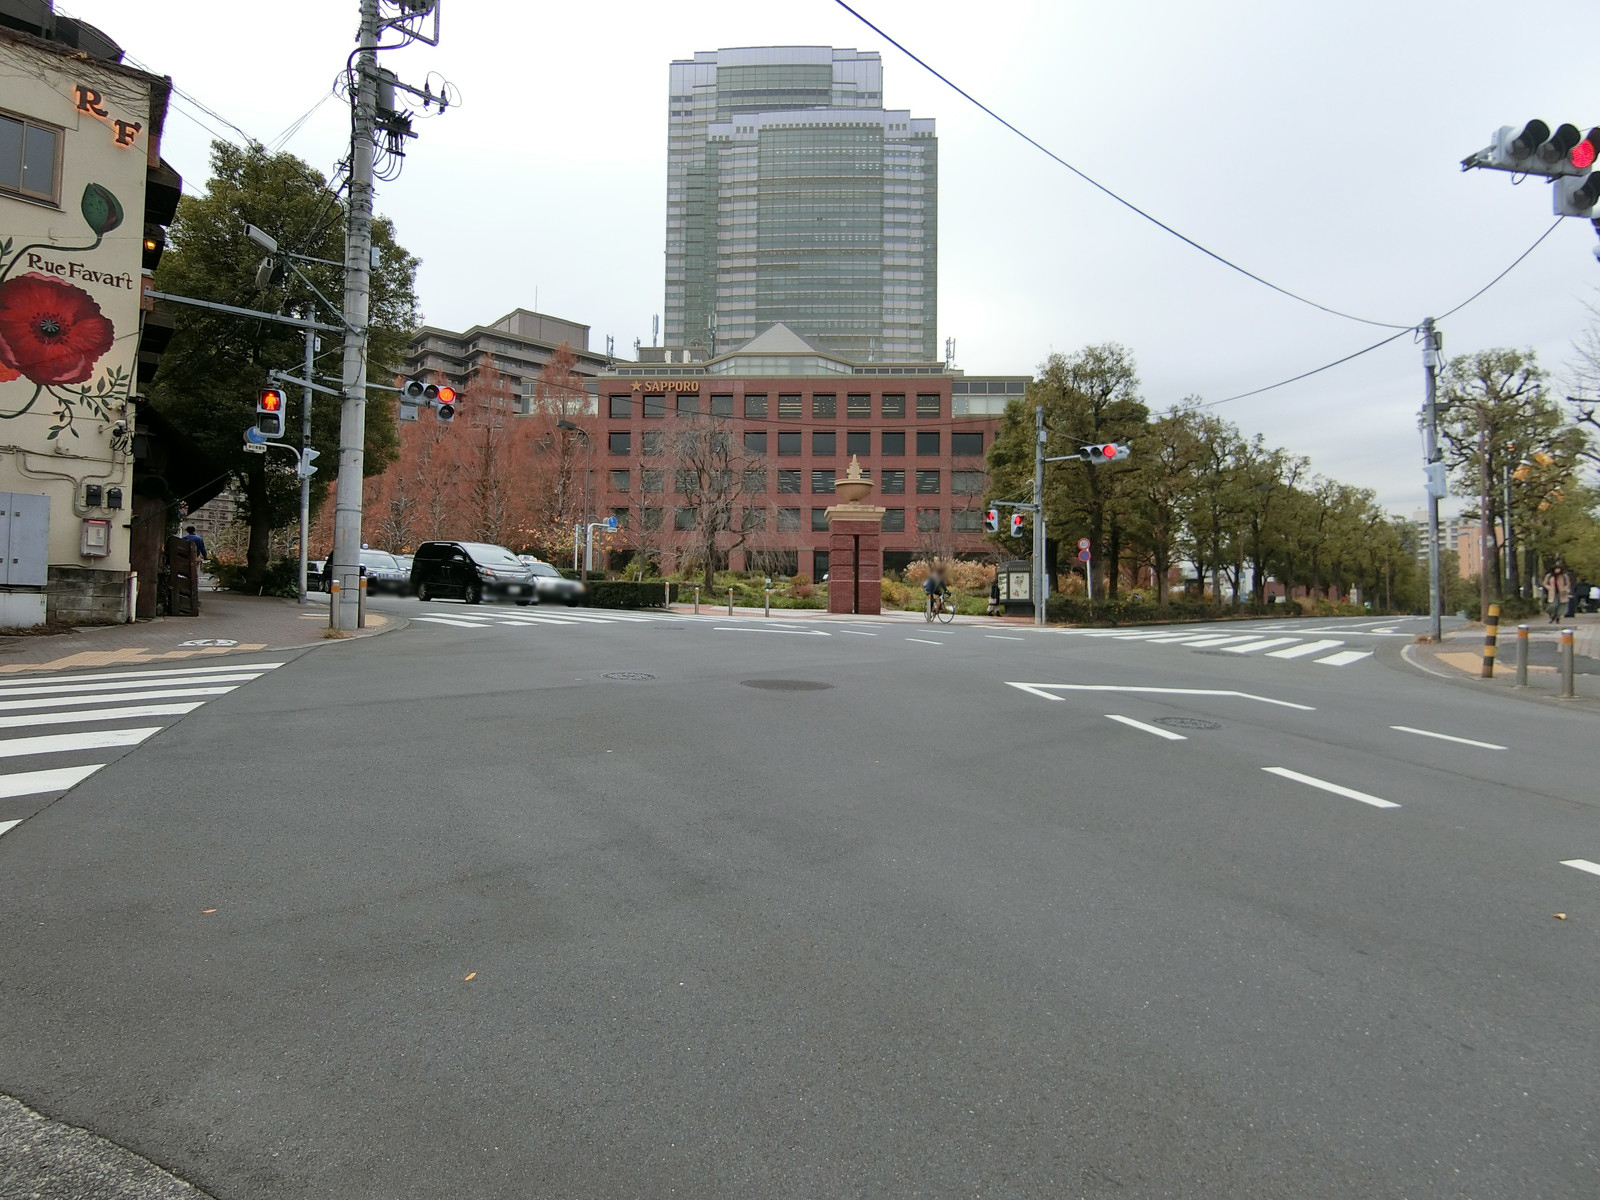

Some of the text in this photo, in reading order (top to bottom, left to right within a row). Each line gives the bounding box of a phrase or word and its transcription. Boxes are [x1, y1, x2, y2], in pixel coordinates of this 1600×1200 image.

[27, 252, 134, 290] Rue Favart
[644, 381, 699, 392] SAPPORO
